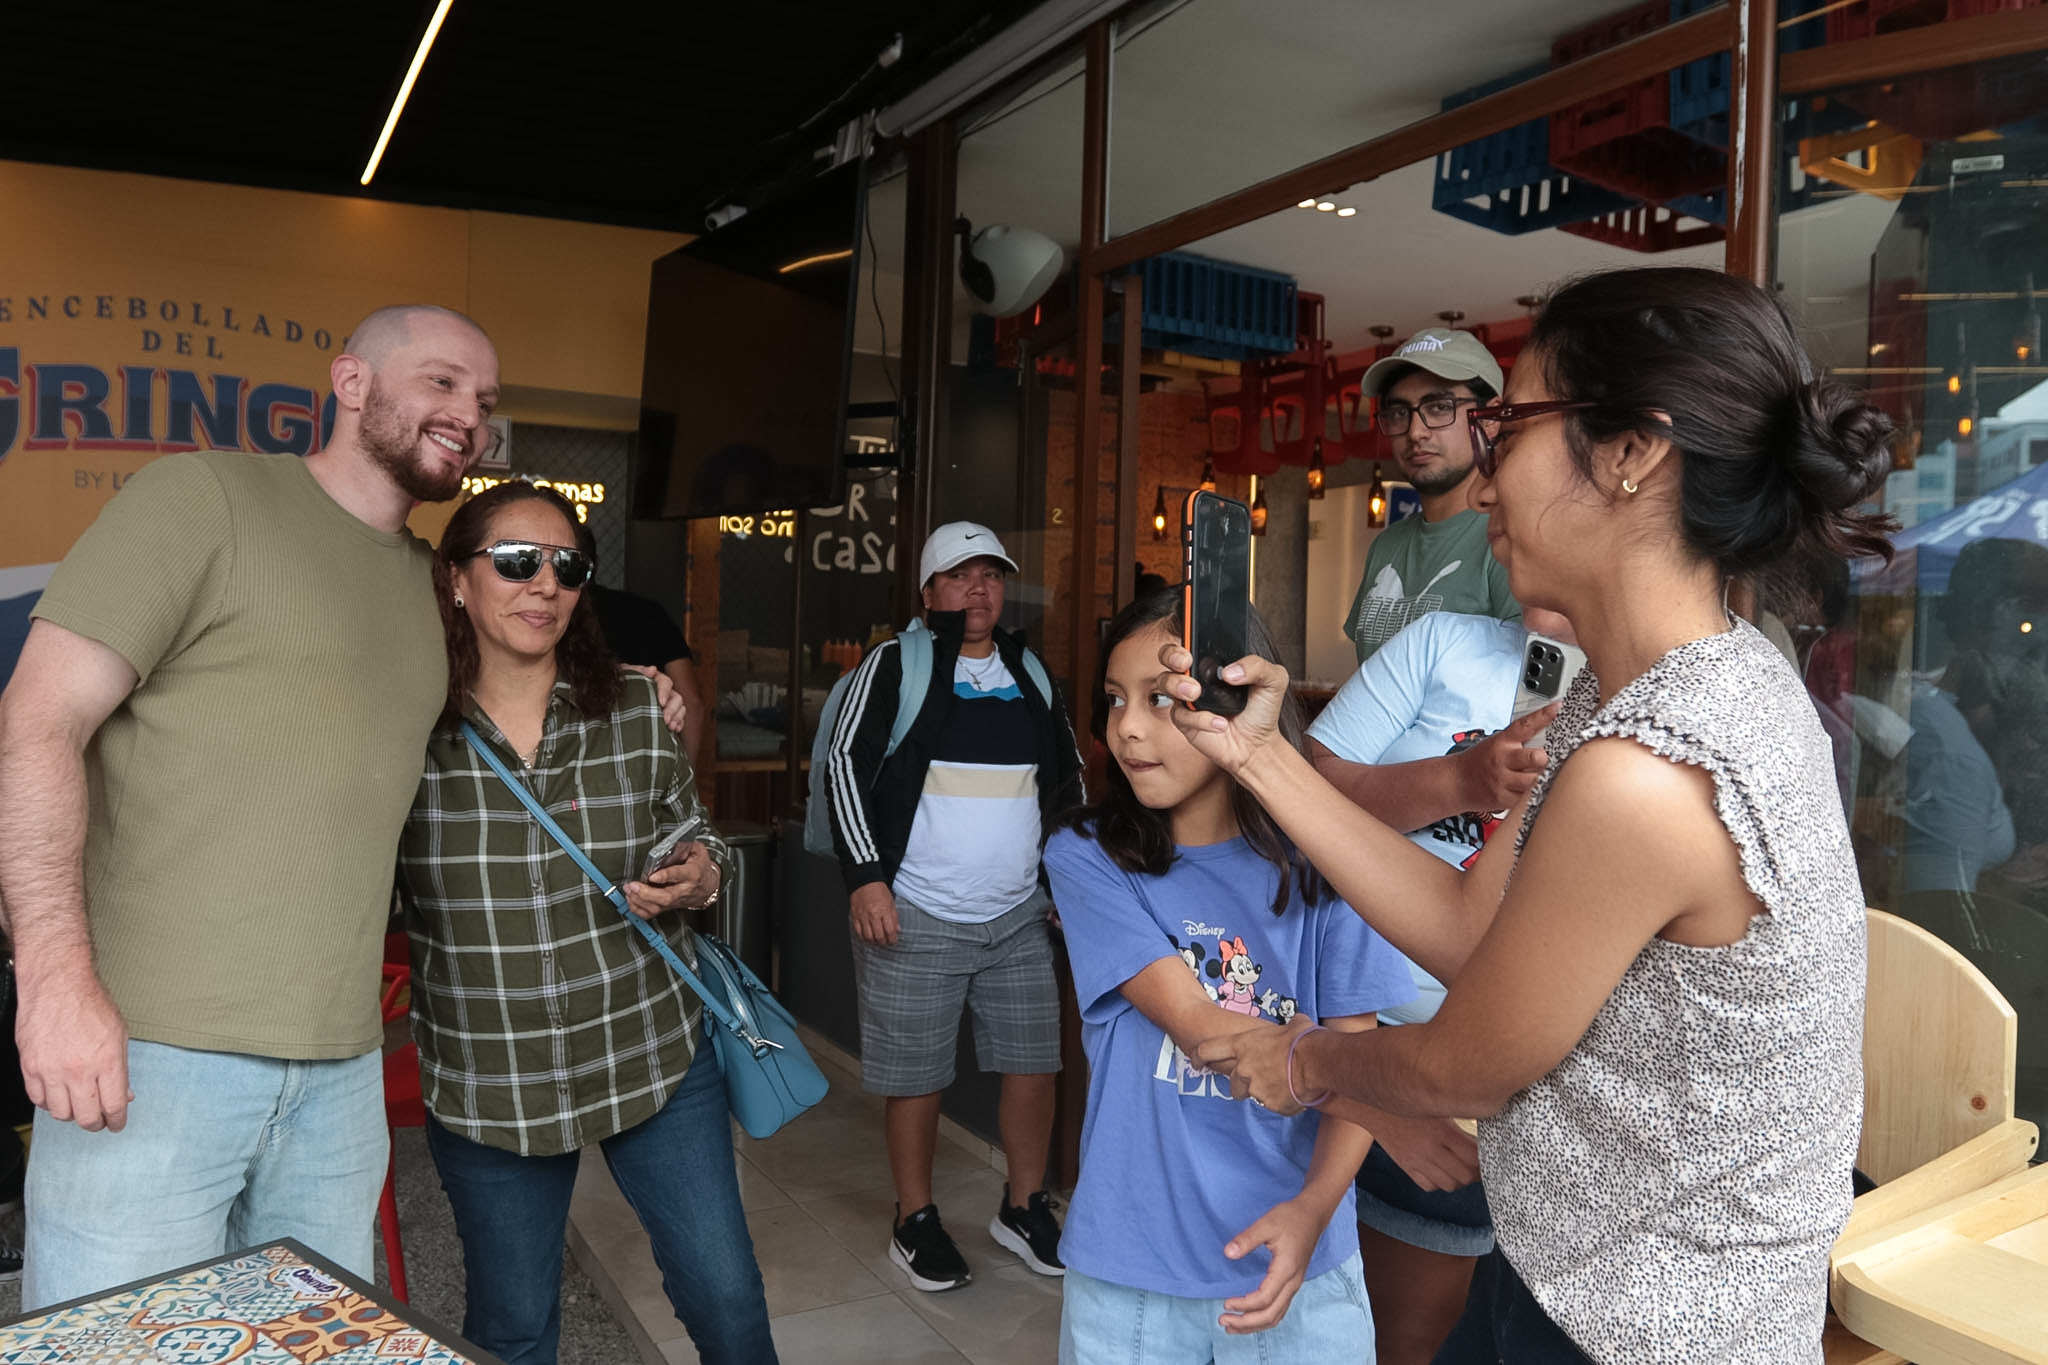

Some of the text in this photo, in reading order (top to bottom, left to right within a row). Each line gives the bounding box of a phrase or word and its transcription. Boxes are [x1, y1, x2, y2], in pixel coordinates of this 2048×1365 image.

[142, 329, 224, 360] DEL
[0, 346, 337, 466] RING
[74, 469, 105, 489] BY
[1182, 919, 1226, 940] Disney
